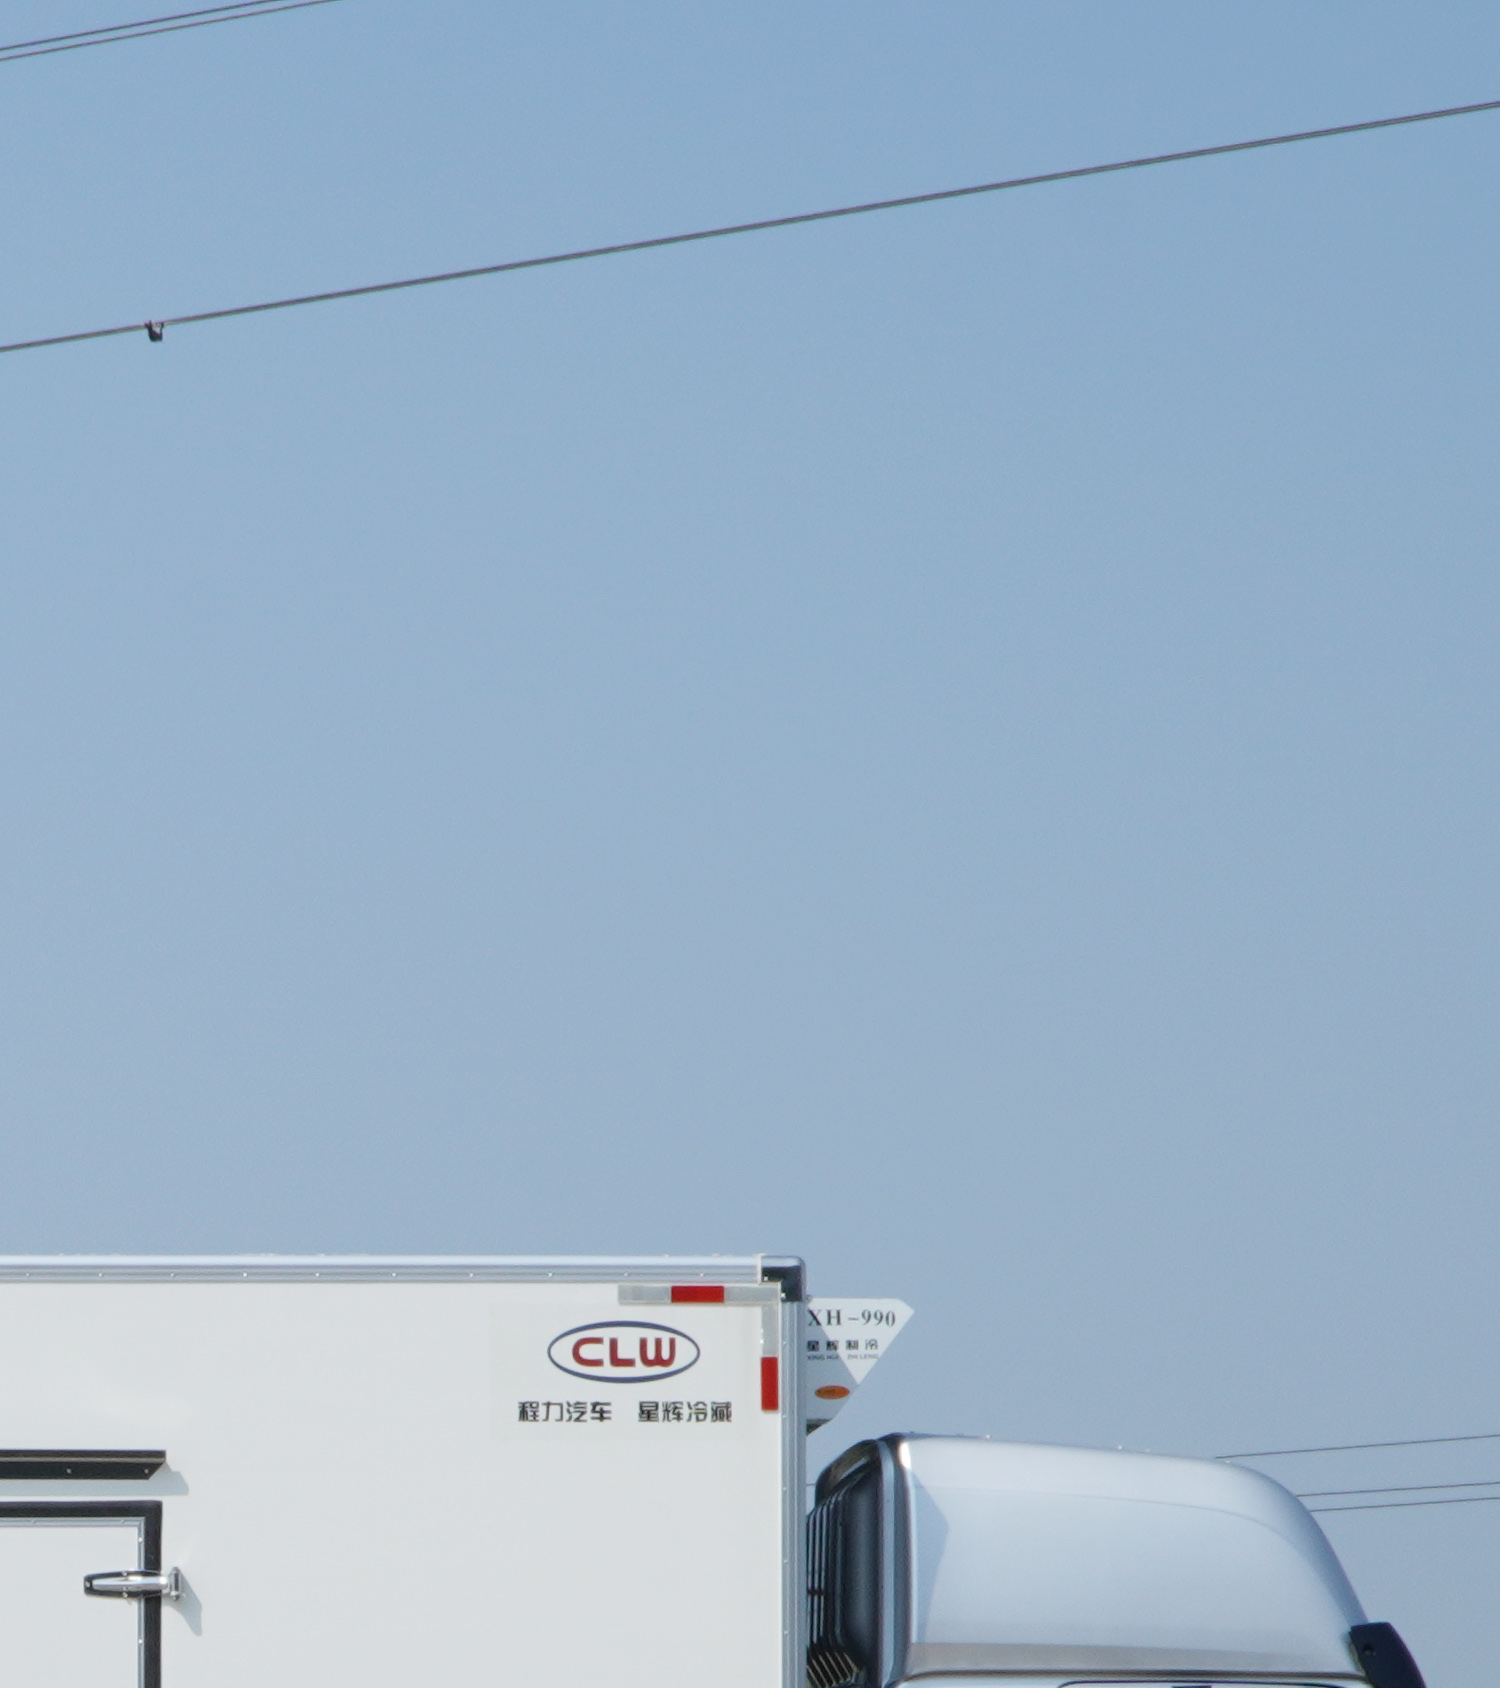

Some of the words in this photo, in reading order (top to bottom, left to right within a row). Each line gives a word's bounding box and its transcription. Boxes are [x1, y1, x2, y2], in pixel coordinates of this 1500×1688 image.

[807, 1309, 896, 1327] XH-990
[572, 1336, 677, 1368] CLW
[517, 1401, 612, 1423] 程力汽车
[638, 1401, 732, 1423] 星辉冷藏
